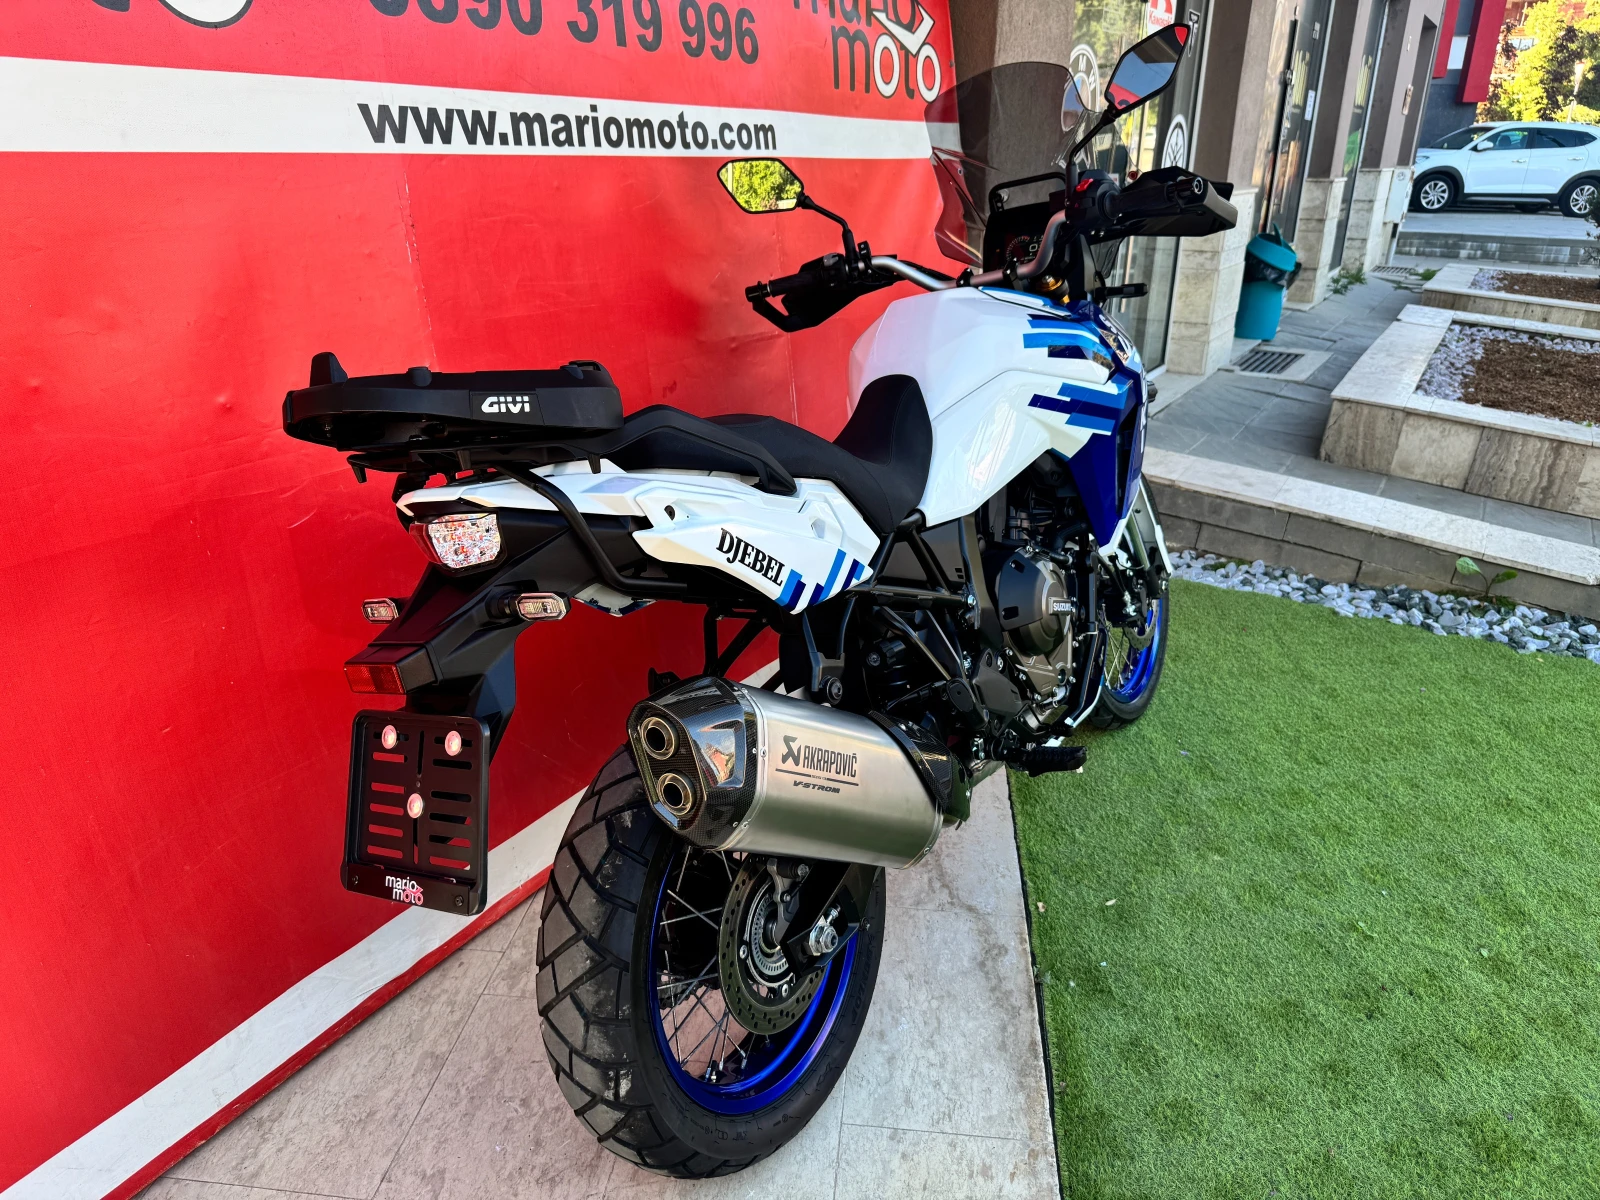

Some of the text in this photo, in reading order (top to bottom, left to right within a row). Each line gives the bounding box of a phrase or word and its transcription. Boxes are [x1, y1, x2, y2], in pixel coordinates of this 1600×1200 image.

[566, 0, 662, 52] 319
[679, 0, 759, 64] 996
[831, 25, 941, 103] moto
[357, 102, 777, 151] www.mariomoto.com
[715, 527, 785, 587] DJEBEL
[793, 780, 840, 794] V-STROM
[386, 876, 417, 891] mario
[393, 888, 423, 905] moto
